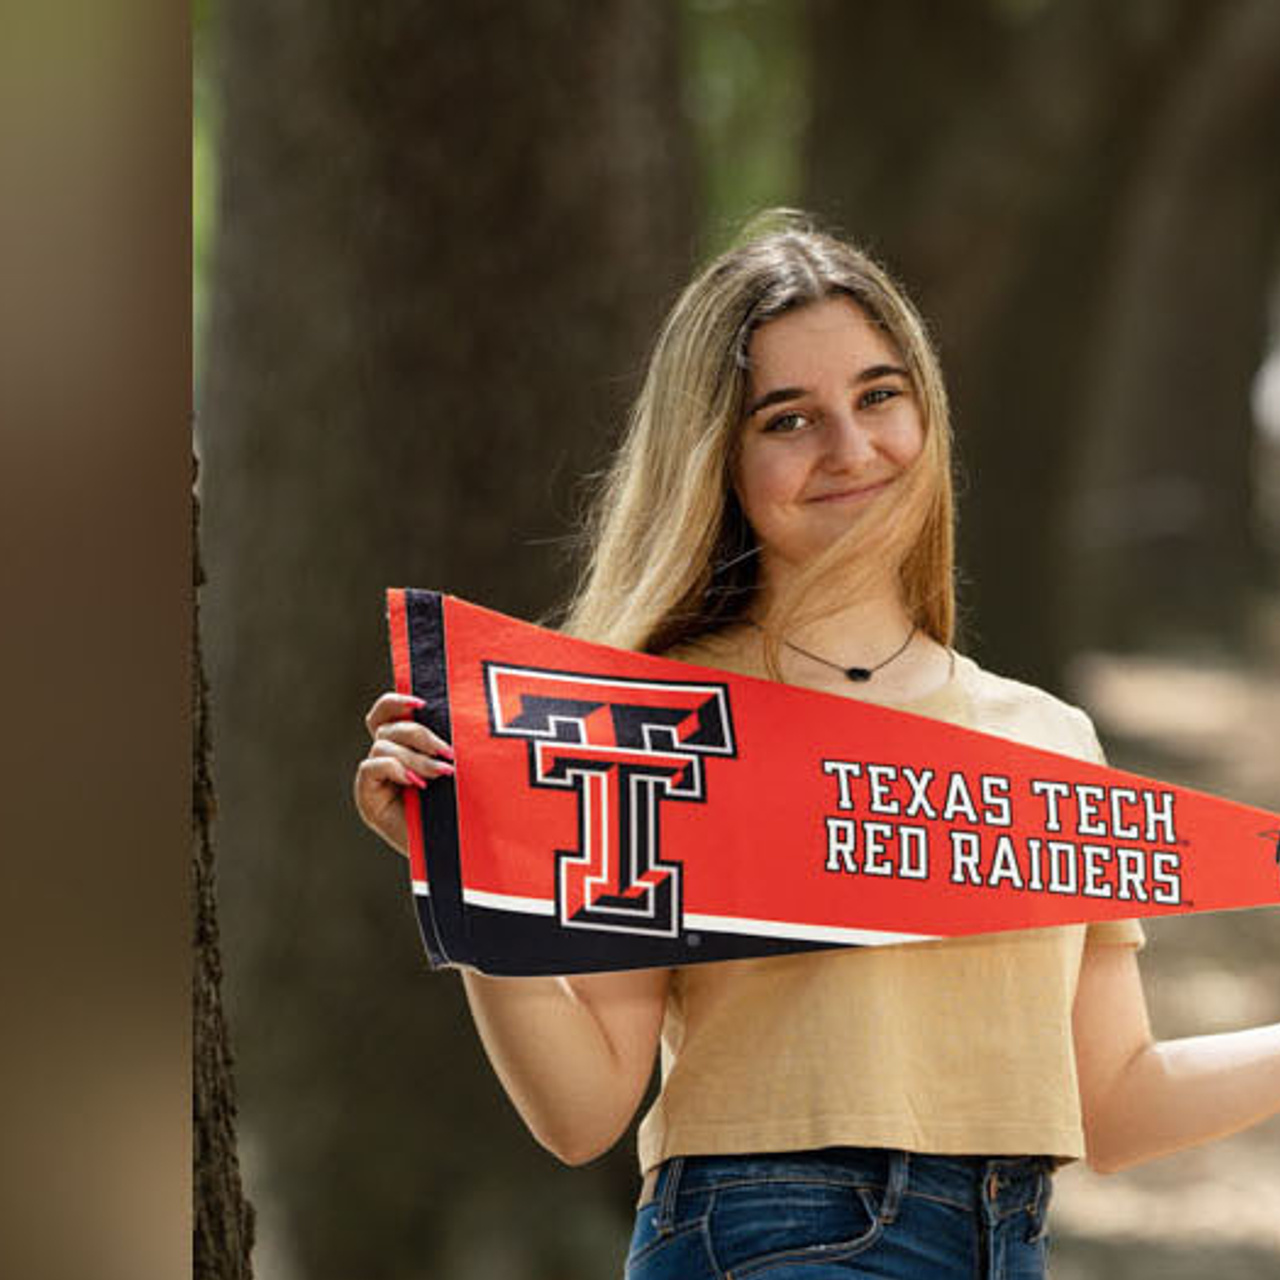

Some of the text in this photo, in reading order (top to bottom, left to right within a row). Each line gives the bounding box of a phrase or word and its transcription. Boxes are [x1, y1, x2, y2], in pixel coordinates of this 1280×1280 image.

[822, 759, 1177, 844] TEXAS TECH
[825, 818, 1182, 905] RED RAIDERS
